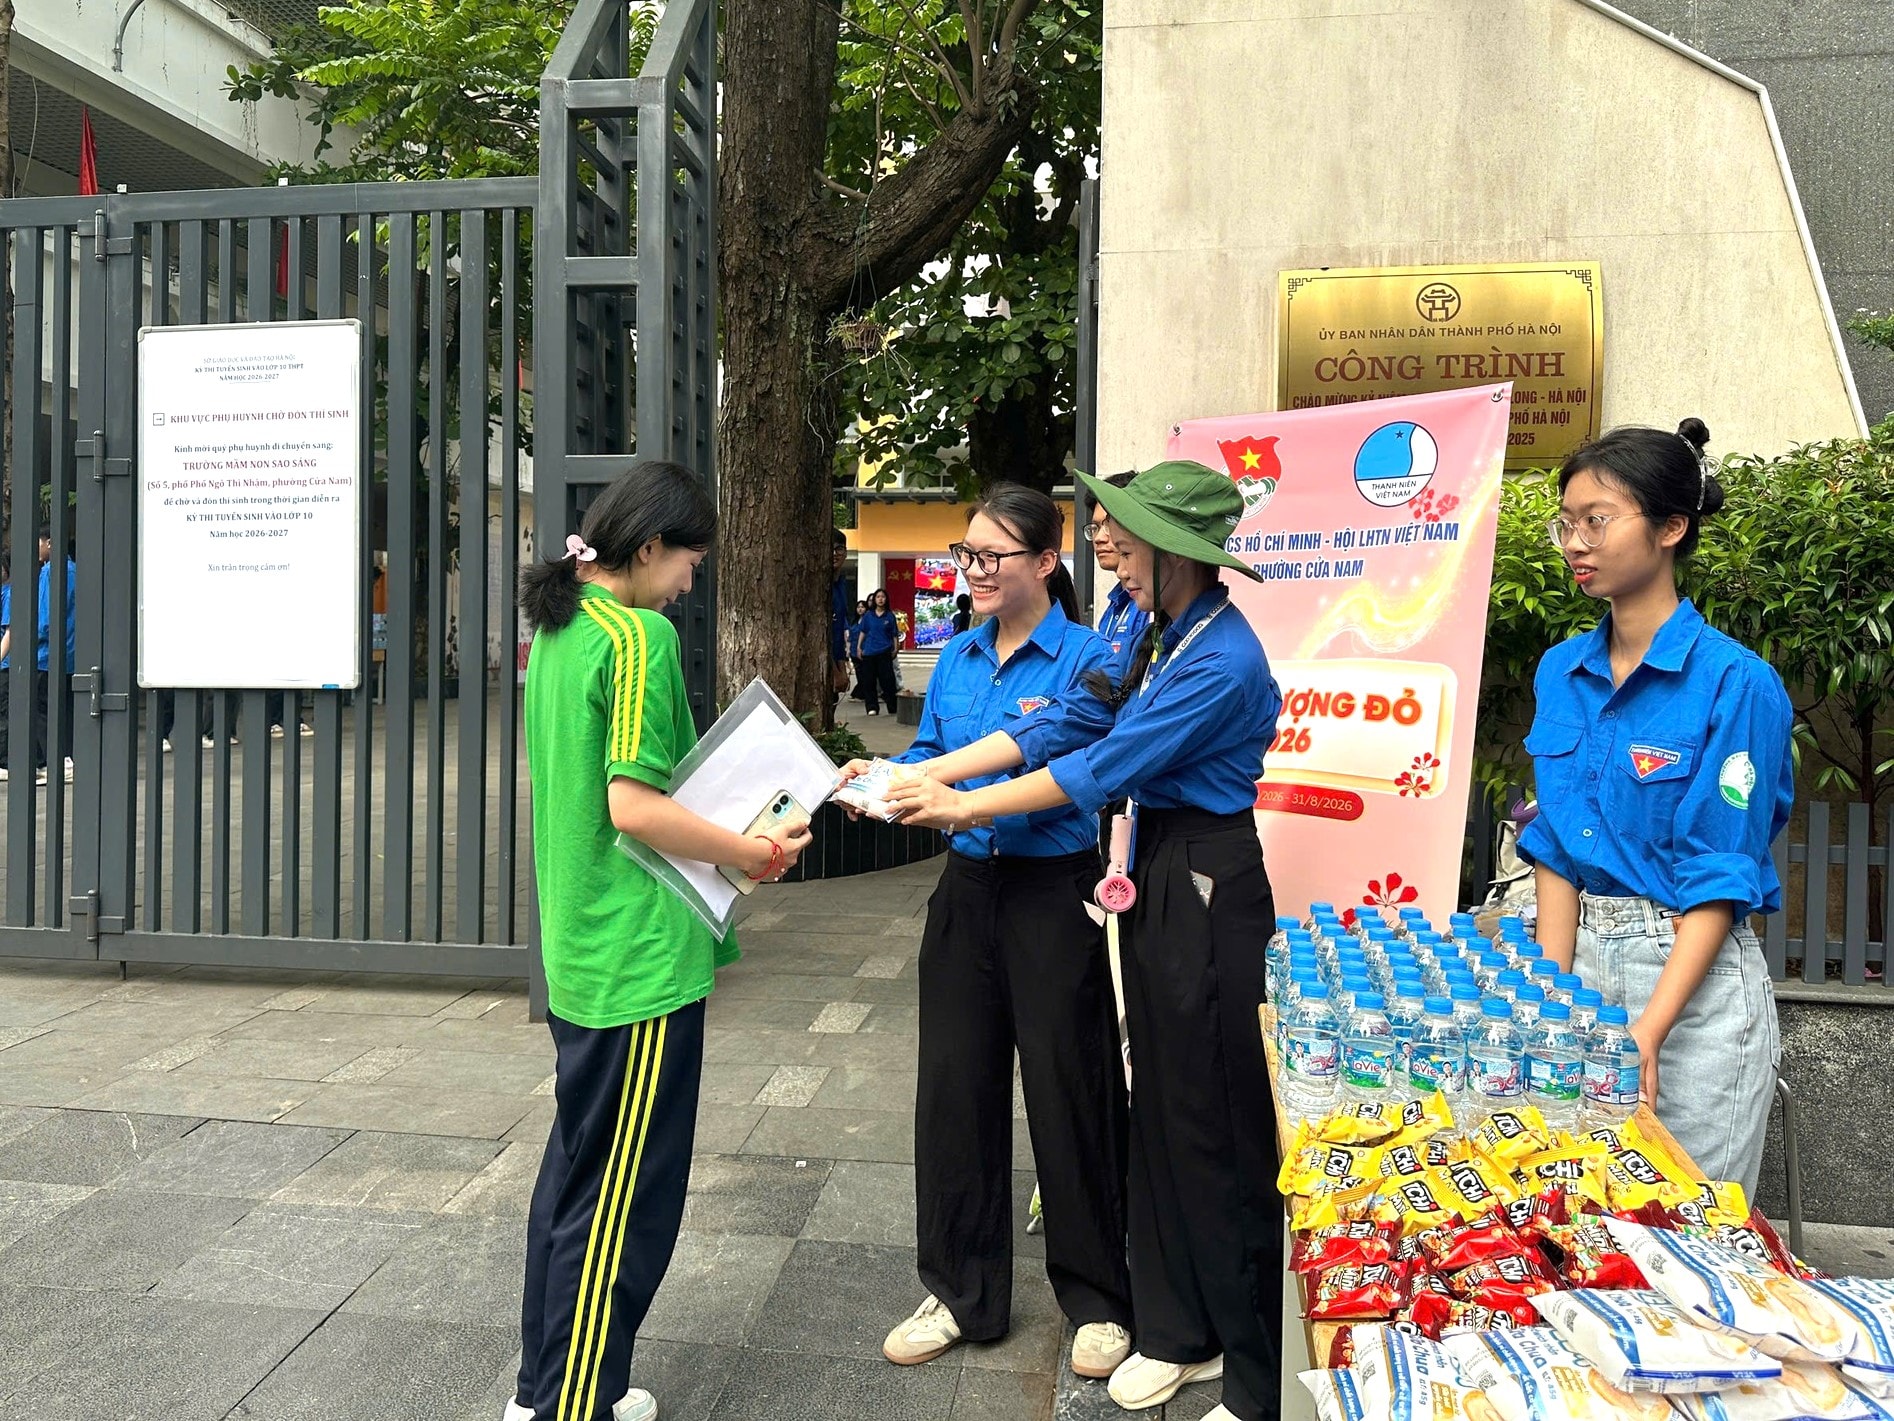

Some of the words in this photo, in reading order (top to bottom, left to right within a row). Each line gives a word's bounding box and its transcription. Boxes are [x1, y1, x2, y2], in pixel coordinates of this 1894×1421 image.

[1319, 328, 1335, 340] ỦY
[1340, 330, 1366, 340] BAN
[1370, 327, 1405, 339] NHÂN
[1409, 326, 1435, 337] DÂN
[1439, 325, 1482, 336] THÀNH
[1487, 322, 1514, 335] PHỐ
[1518, 323, 1535, 335] HÀ
[1539, 322, 1561, 336] NỘI
[1315, 348, 1425, 382] CÔNG
[1436, 346, 1565, 378] TRÌNH
[1293, 392, 1320, 408] CHÀO
[1548, 387, 1563, 404] HÀ
[1567, 387, 1586, 406] NỘI
[171, 415, 189, 423] KHU
[191, 414, 210, 424] VỰC
[212, 413, 231, 423] PHỤ
[232, 412, 264, 421] HUYNH
[327, 410, 349, 418] SINH
[1509, 407, 1529, 425] PHỐ
[1532, 409, 1547, 424] HÀ
[1550, 408, 1570, 427] NỘI
[245, 443, 270, 452] huynh
[1507, 433, 1535, 446] 2025
[183, 460, 223, 470] TRƯỜNG
[250, 460, 270, 469] NON
[272, 460, 290, 468] SAO
[292, 457, 317, 468] SÁNG
[1372, 482, 1397, 490] THANH
[250, 497, 272, 506] trong
[292, 496, 310, 504] gian
[284, 511, 301, 519] LỚP
[229, 530, 243, 539] học
[1227, 537, 1241, 552] CS
[1245, 531, 1261, 552] HỒ
[1264, 531, 1285, 551] CHÍ
[1288, 533, 1321, 550] MINH
[1334, 528, 1355, 552] HỘI
[1359, 528, 1391, 547] LHTN
[1394, 522, 1421, 546] VIỆT
[1423, 523, 1459, 540] NAM
[1253, 559, 1302, 580] PHƯỜNG
[1306, 556, 1330, 578] CỬA
[1334, 560, 1363, 577] NAM
[1280, 688, 1356, 724] ƯỢNG
[1363, 687, 1422, 726] ĐỎ
[1269, 727, 1311, 752] 26
[1260, 791, 1284, 802] /2026
[1292, 793, 1352, 811] 31/8/2026
